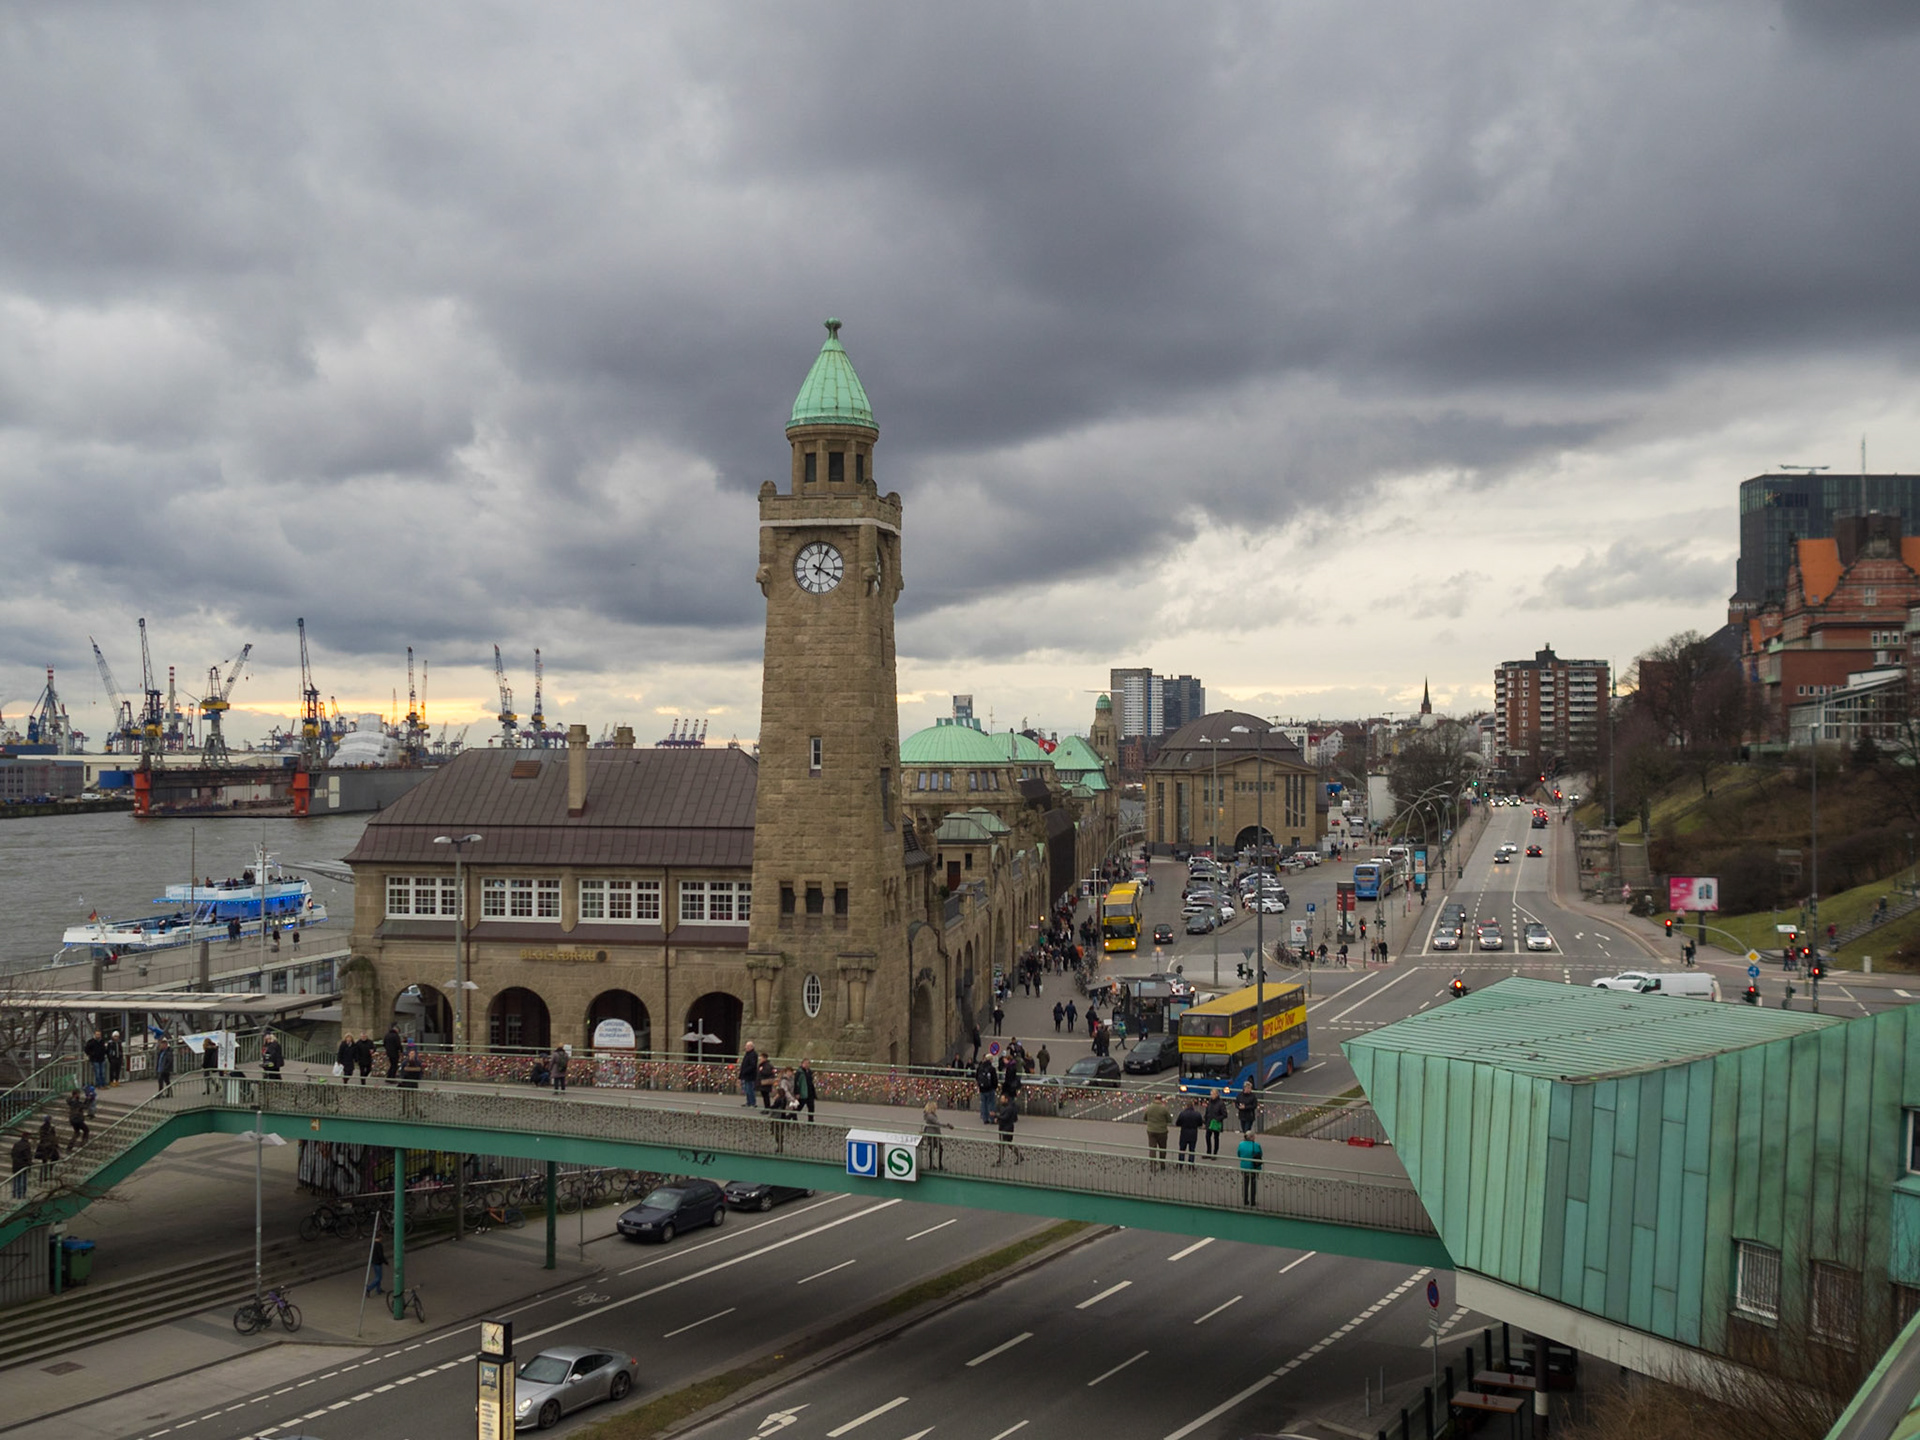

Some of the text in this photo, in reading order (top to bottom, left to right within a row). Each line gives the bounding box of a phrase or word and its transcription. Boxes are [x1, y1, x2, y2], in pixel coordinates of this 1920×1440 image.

[1275, 1016, 1283, 1031] City
[1284, 1012, 1295, 1026] Tour
[851, 1144, 872, 1172] U
[891, 1149, 910, 1175] S
